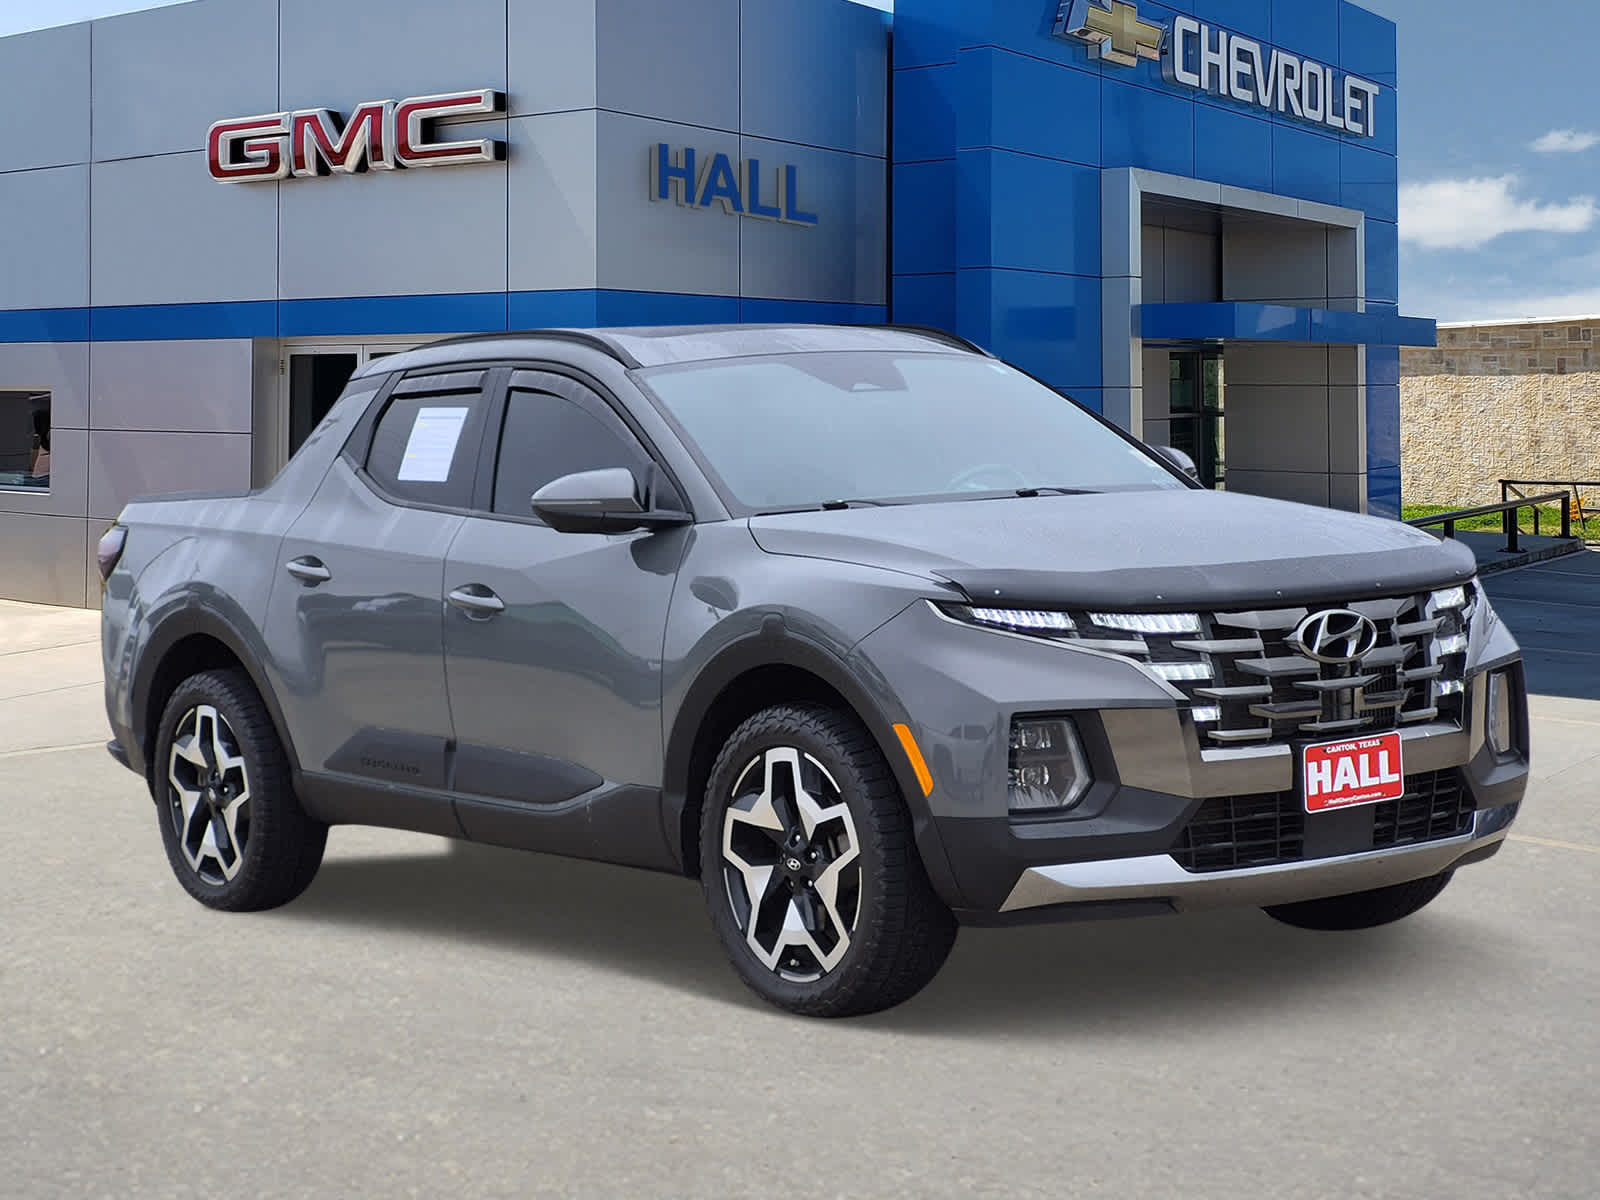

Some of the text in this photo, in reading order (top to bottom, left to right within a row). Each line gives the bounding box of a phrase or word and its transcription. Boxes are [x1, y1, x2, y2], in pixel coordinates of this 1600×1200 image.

[1174, 16, 1380, 137] CHEVROLET
[207, 88, 506, 183] GMC
[652, 143, 818, 226] HALL
[1307, 750, 1400, 796] HALL
[1359, 739, 1381, 748] TEXAS
